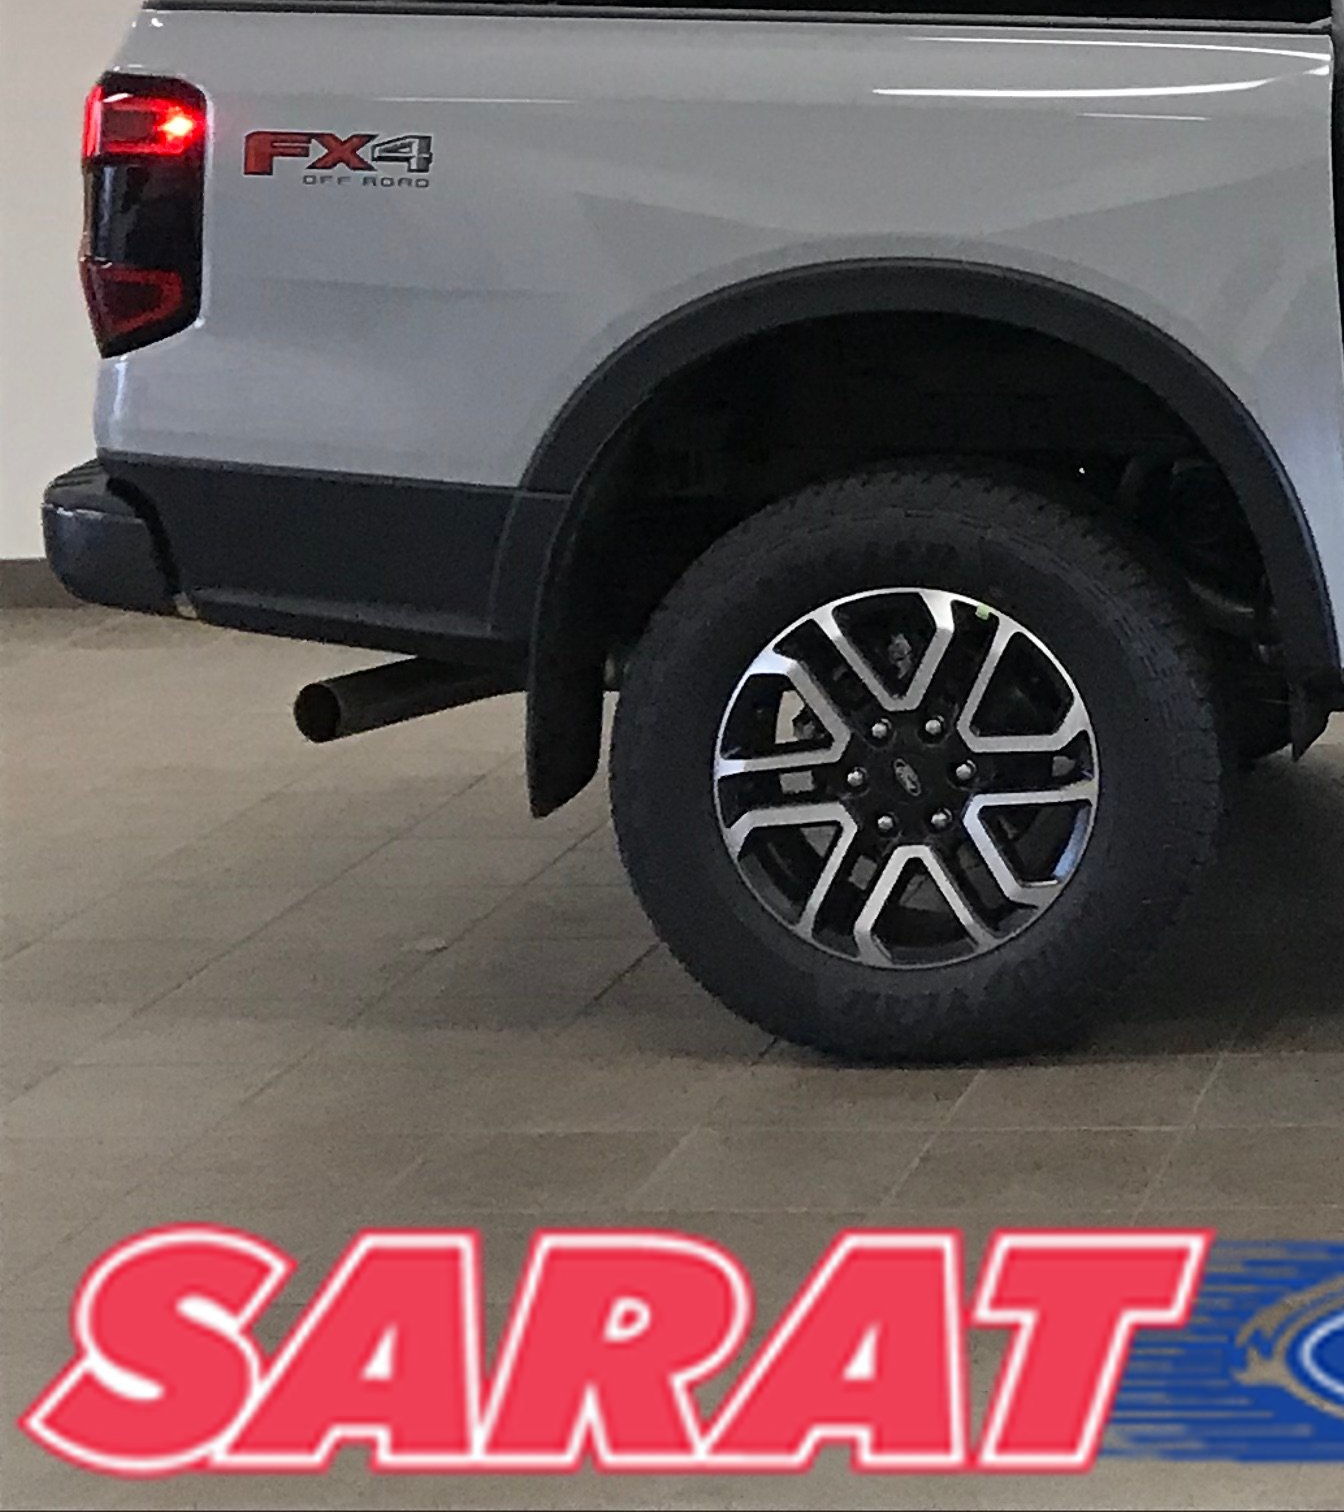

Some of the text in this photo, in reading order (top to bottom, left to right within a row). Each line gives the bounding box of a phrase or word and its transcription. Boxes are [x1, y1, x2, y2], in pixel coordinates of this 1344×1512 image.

[243, 130, 433, 176] FX4
[303, 174, 429, 189] OFF ROAD
